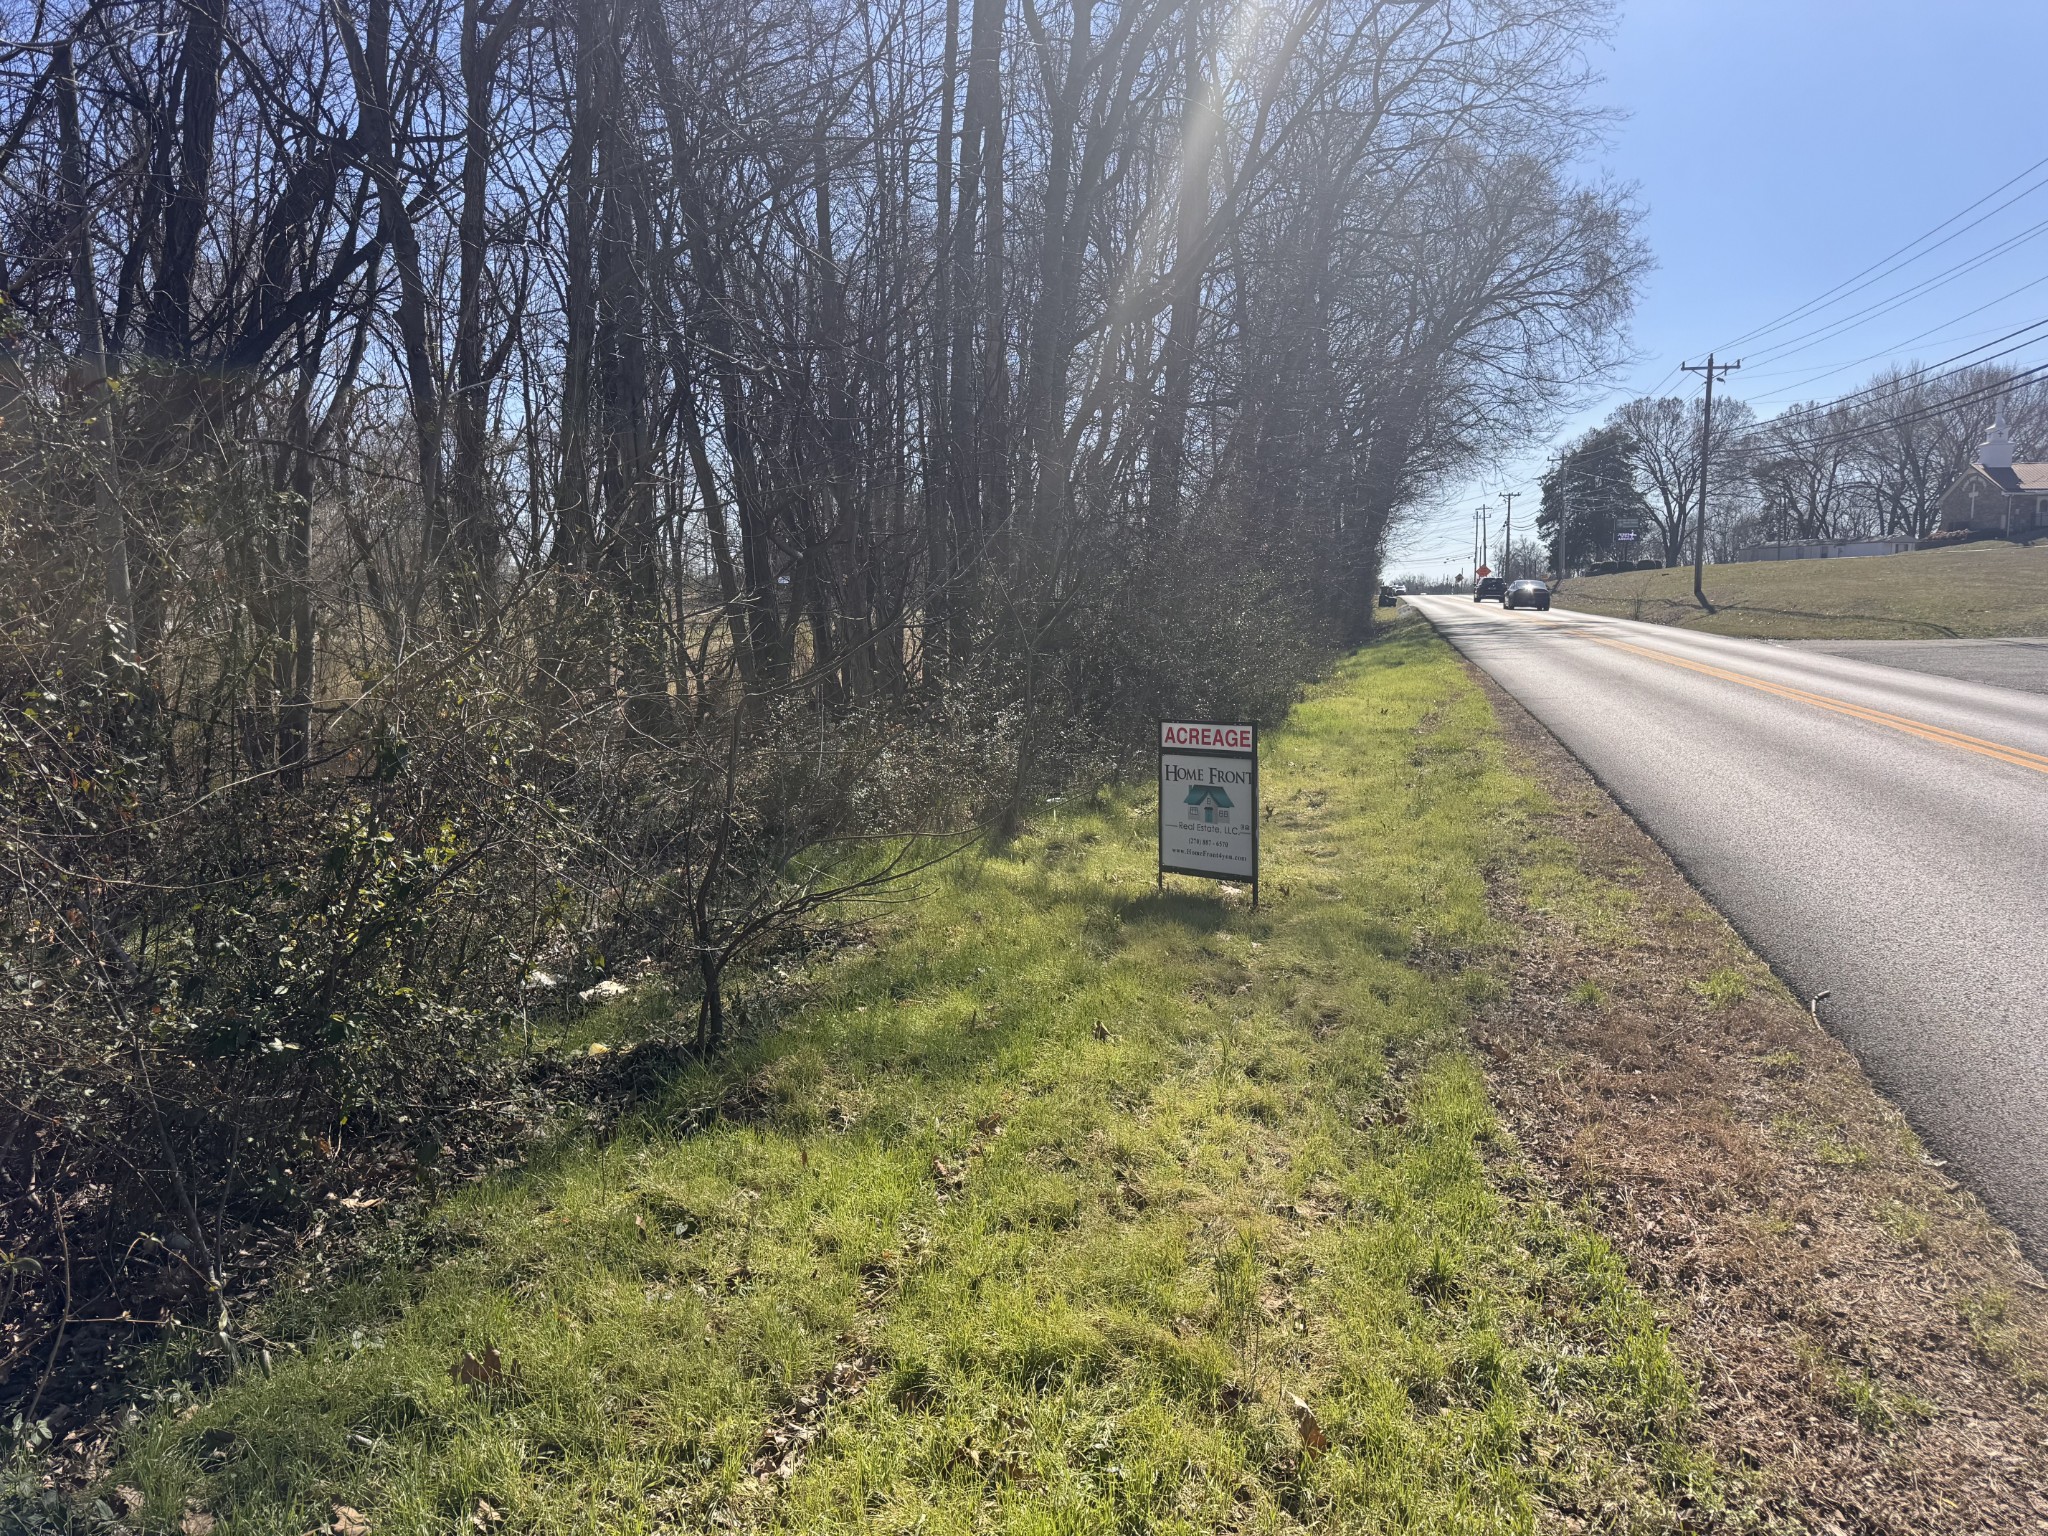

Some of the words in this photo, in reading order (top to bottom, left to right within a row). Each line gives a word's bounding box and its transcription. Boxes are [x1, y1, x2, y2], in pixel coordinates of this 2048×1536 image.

[1164, 726, 1251, 748] ACREAGE
[1165, 764, 1204, 782] HOME
[1178, 821, 1195, 831] Real
